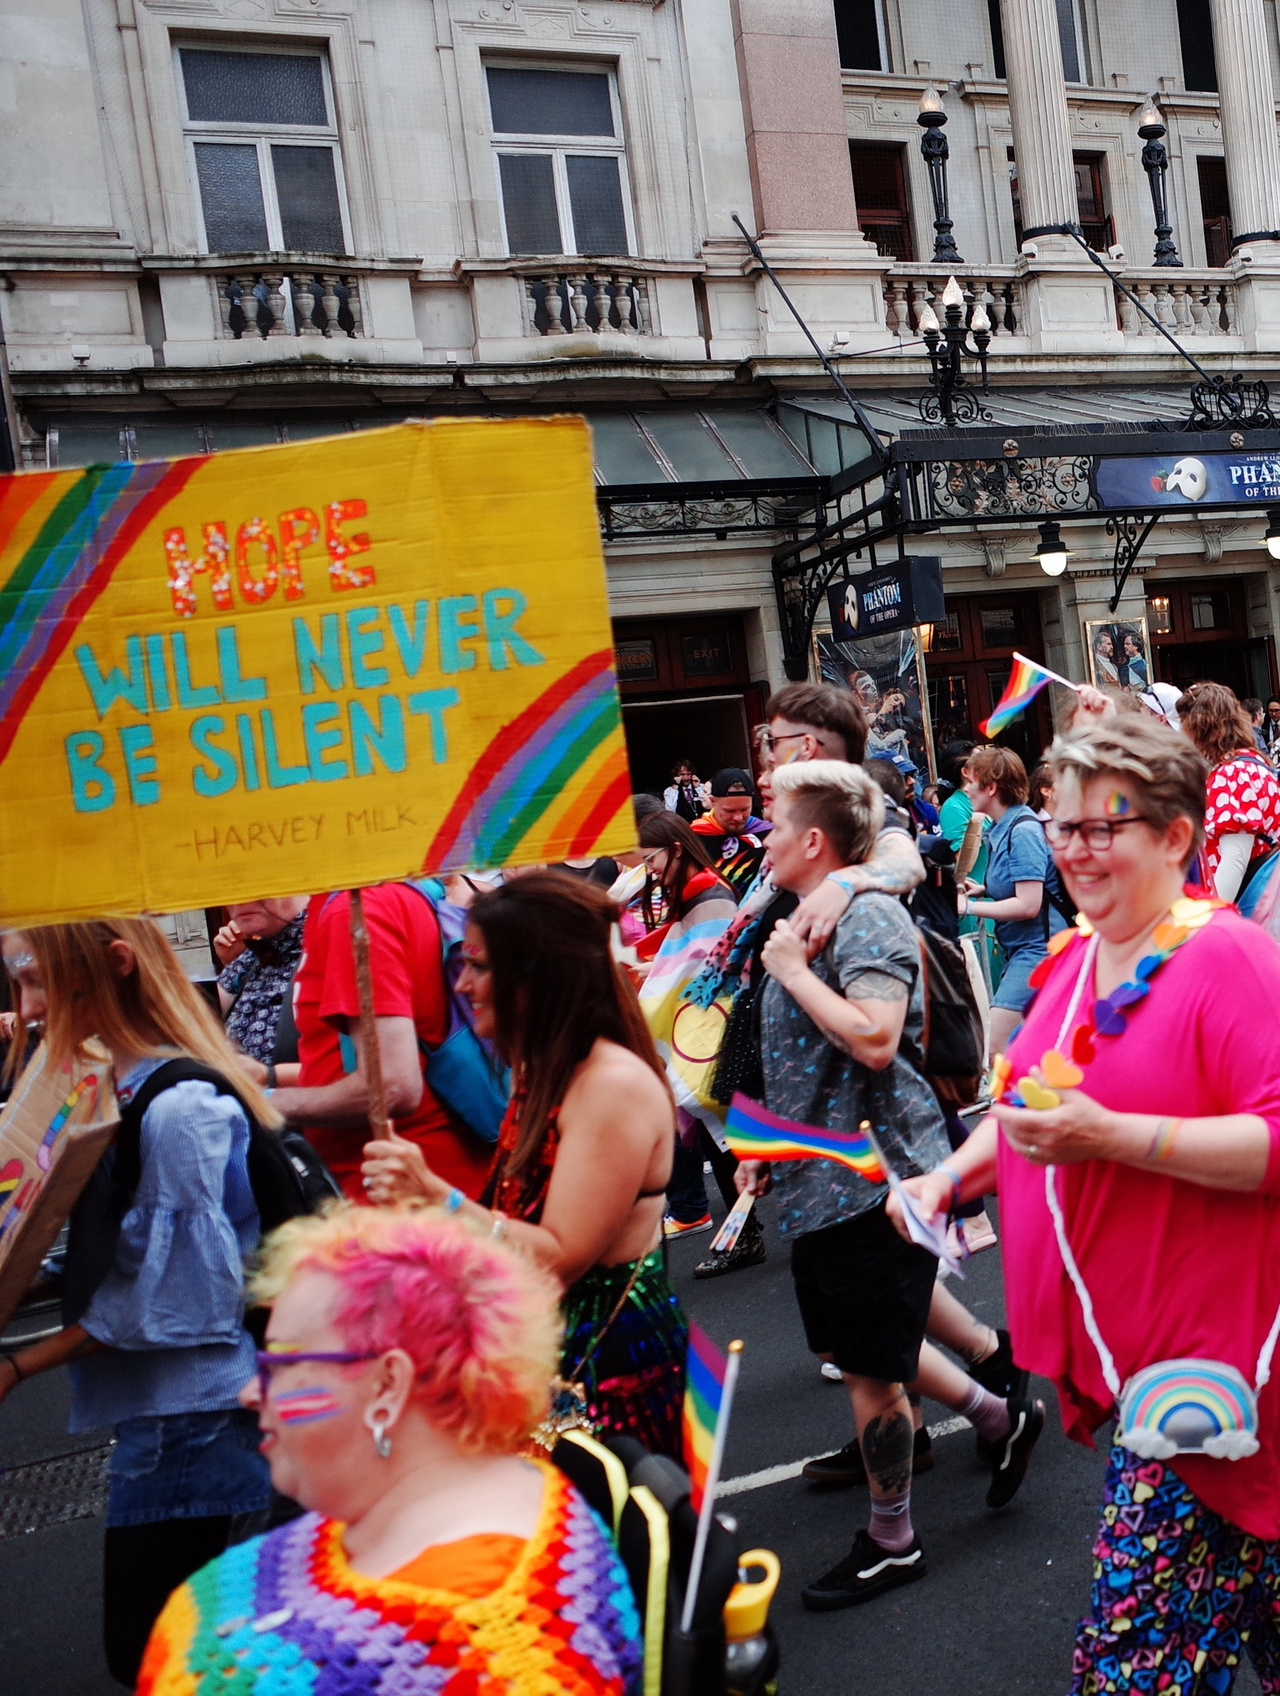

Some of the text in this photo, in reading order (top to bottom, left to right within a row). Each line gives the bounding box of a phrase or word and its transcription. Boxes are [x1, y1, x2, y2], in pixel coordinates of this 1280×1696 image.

[1245, 487, 1259, 497] OF
[163, 498, 376, 619] HOPE
[862, 582, 902, 612] PHANTOM
[869, 609, 898, 624] OF THE OPERA
[74, 587, 546, 722] WILL NEVER
[693, 648, 720, 659] EXIT
[64, 686, 460, 813] BE SILENT
[345, 804, 417, 837] MILK
